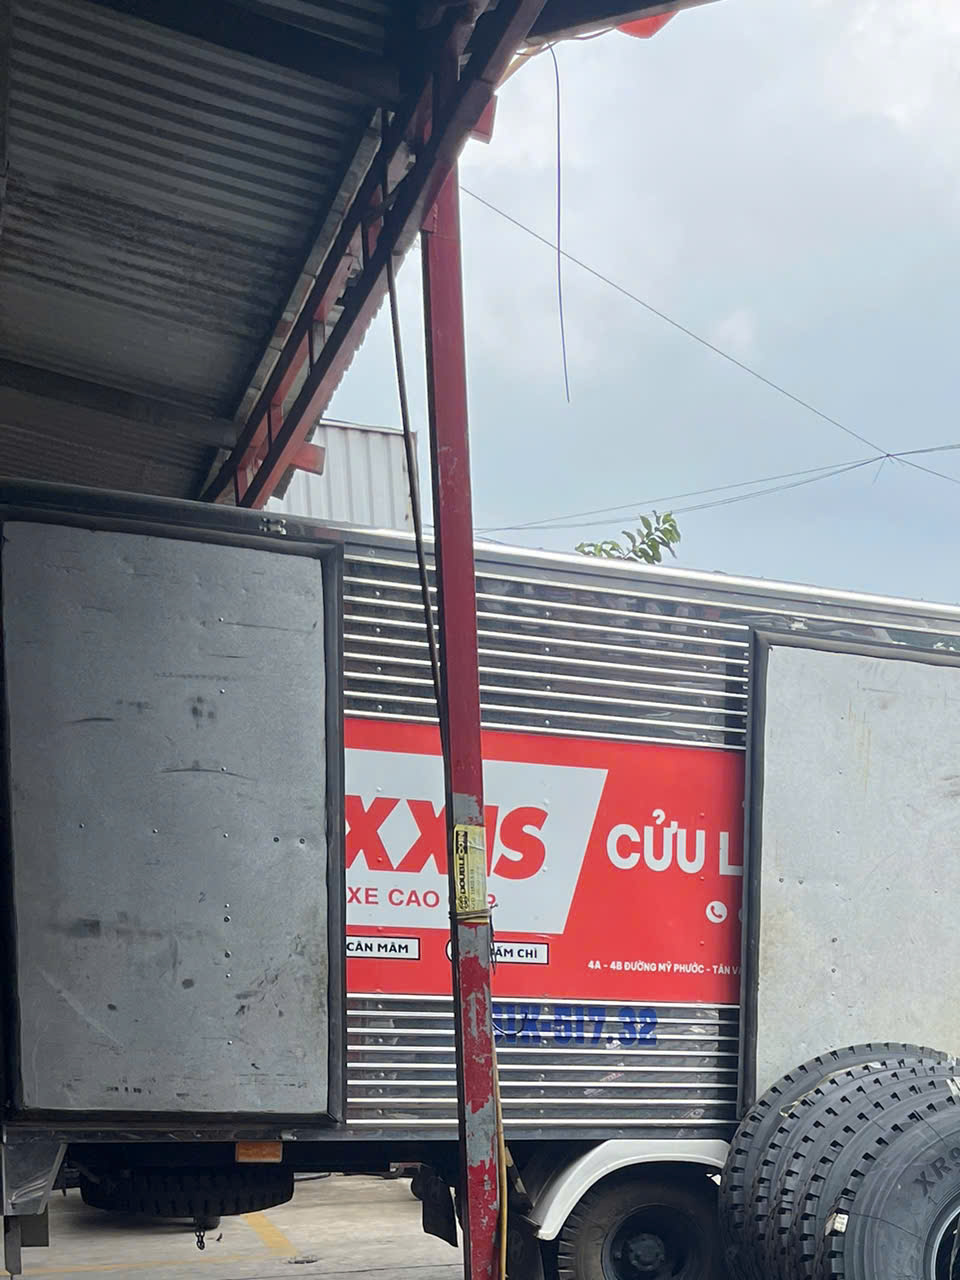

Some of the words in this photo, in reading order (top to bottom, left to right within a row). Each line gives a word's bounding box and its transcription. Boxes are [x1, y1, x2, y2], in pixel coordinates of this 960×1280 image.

[457, 831, 466, 855] COIN
[606, 808, 706, 874] CỬU
[719, 831, 744, 876] L
[458, 855, 466, 894] DOUBLE
[347, 886, 379, 905] XE
[388, 889, 440, 908] CAO
[587, 960, 601, 970] 4A
[609, 961, 623, 971] 4B
